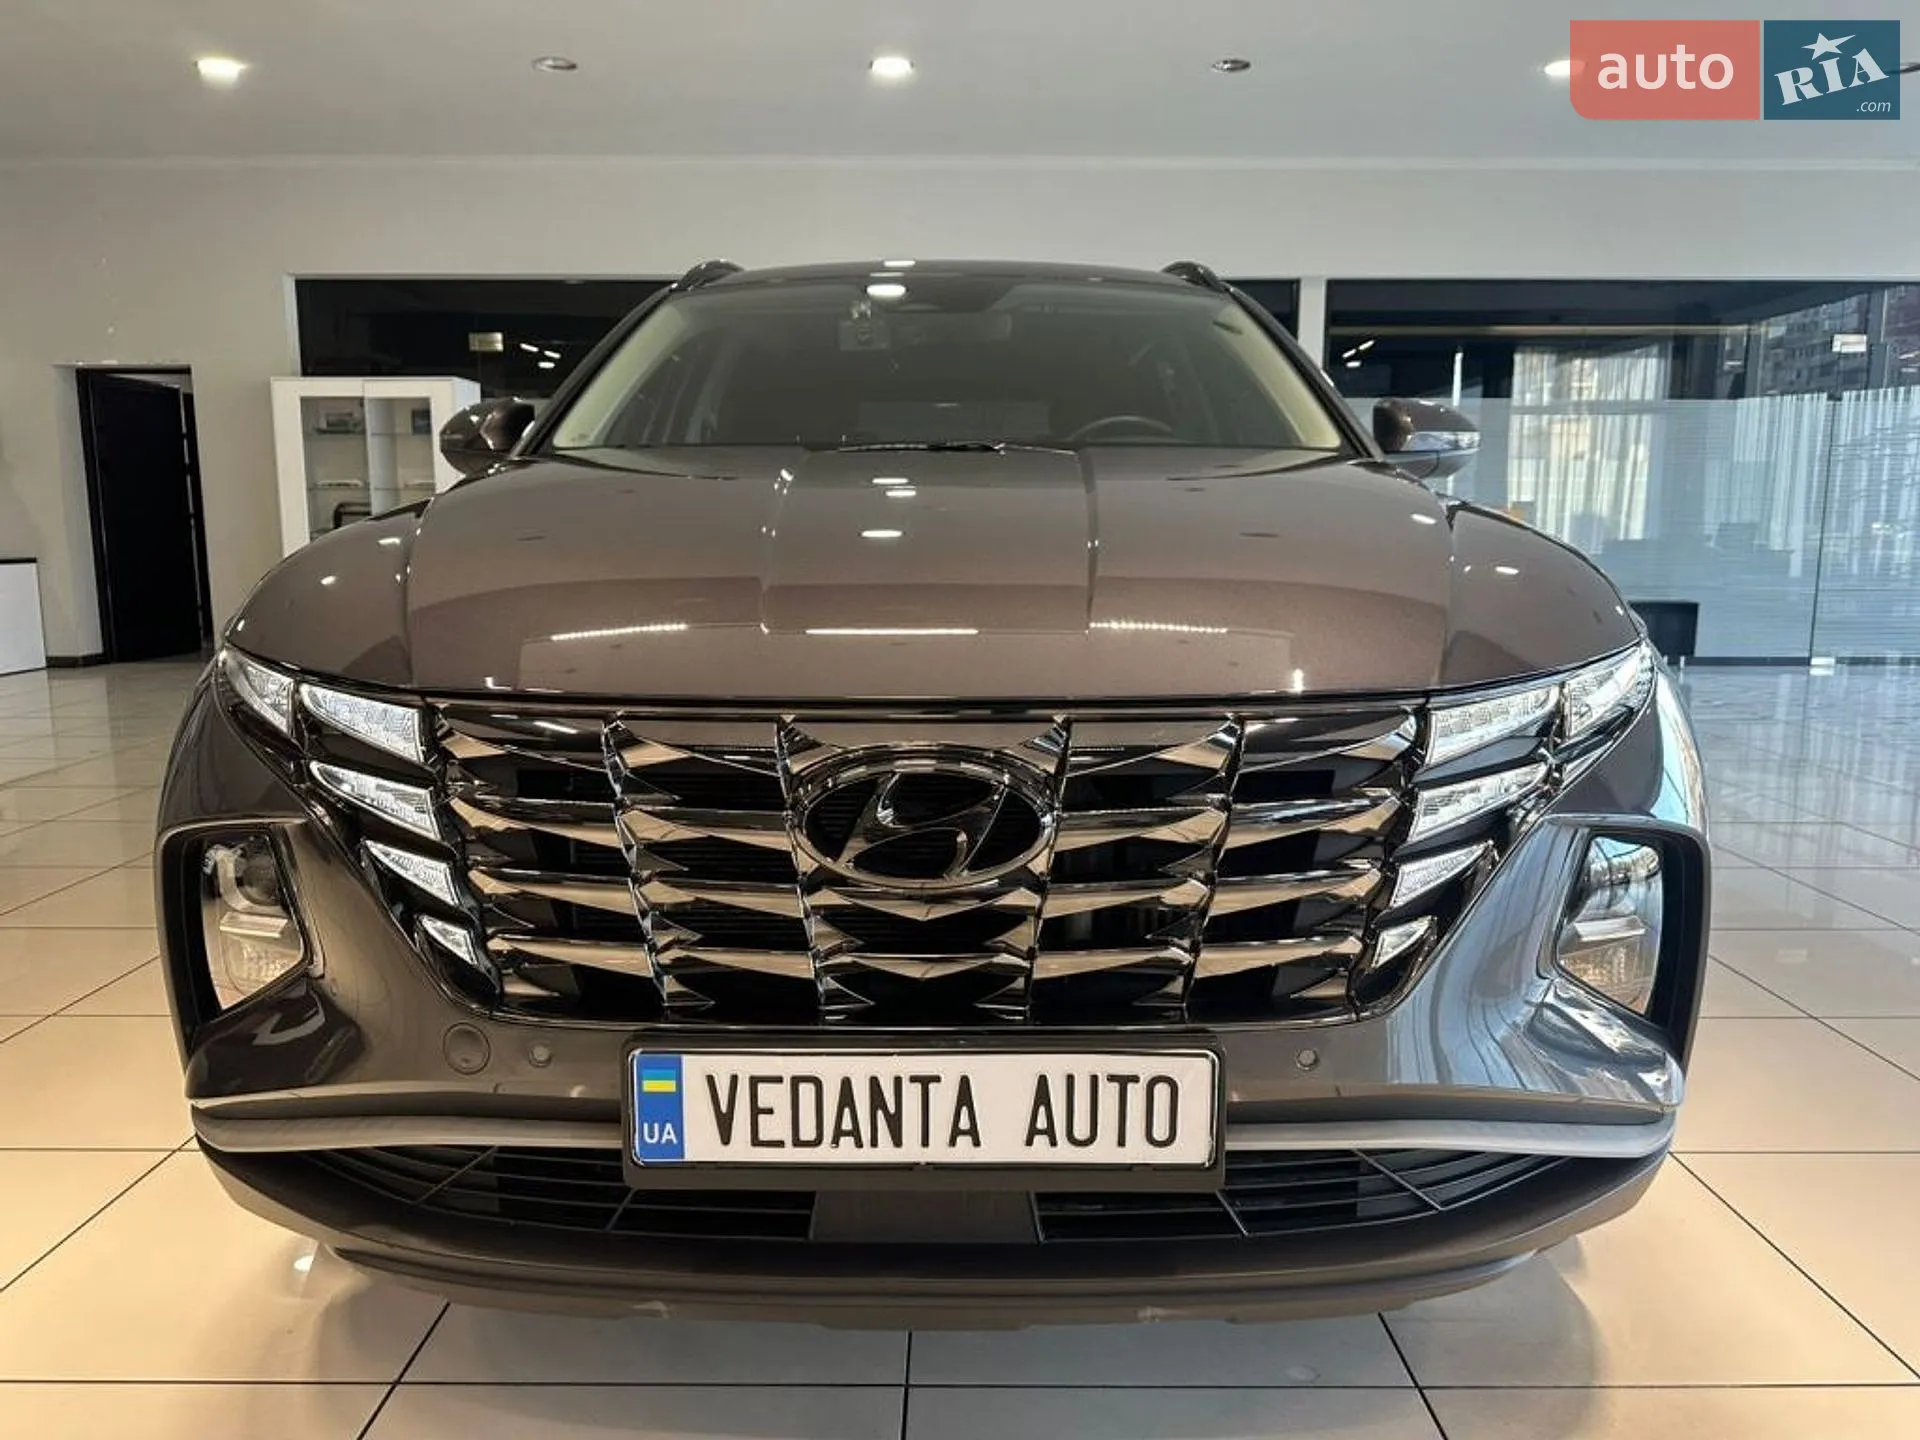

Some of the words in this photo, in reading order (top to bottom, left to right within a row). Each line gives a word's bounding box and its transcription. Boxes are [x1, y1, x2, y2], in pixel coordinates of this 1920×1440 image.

[643, 1121, 678, 1145] UA
[705, 1073, 982, 1149] VEDANTA
[1024, 1073, 1179, 1149] AUTO
